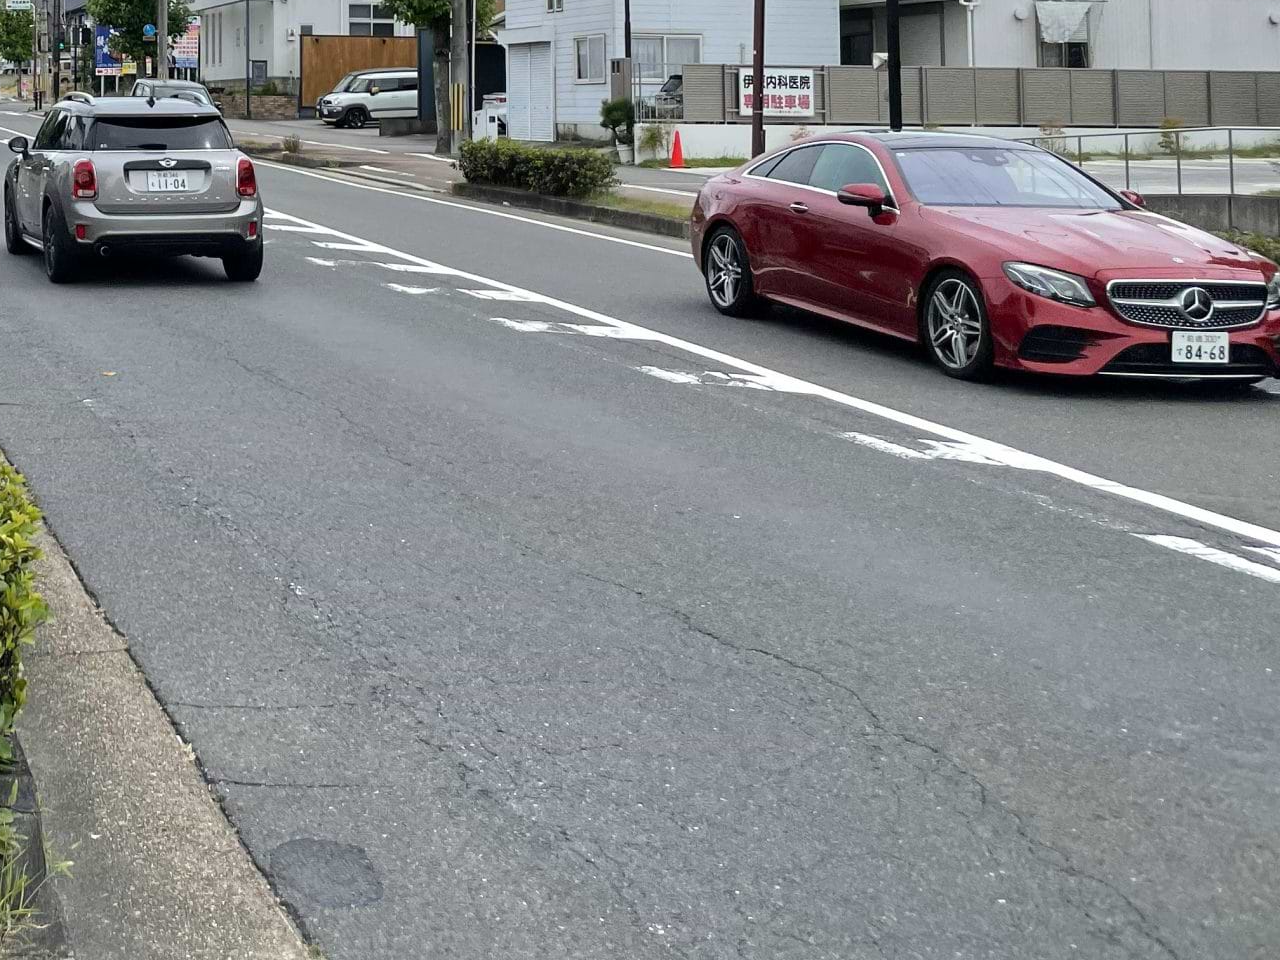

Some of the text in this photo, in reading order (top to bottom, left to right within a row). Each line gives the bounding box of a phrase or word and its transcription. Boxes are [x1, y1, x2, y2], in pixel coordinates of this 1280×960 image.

[743, 75, 810, 89] 伊内科医院
[1185, 345, 1225, 360] 84-68
